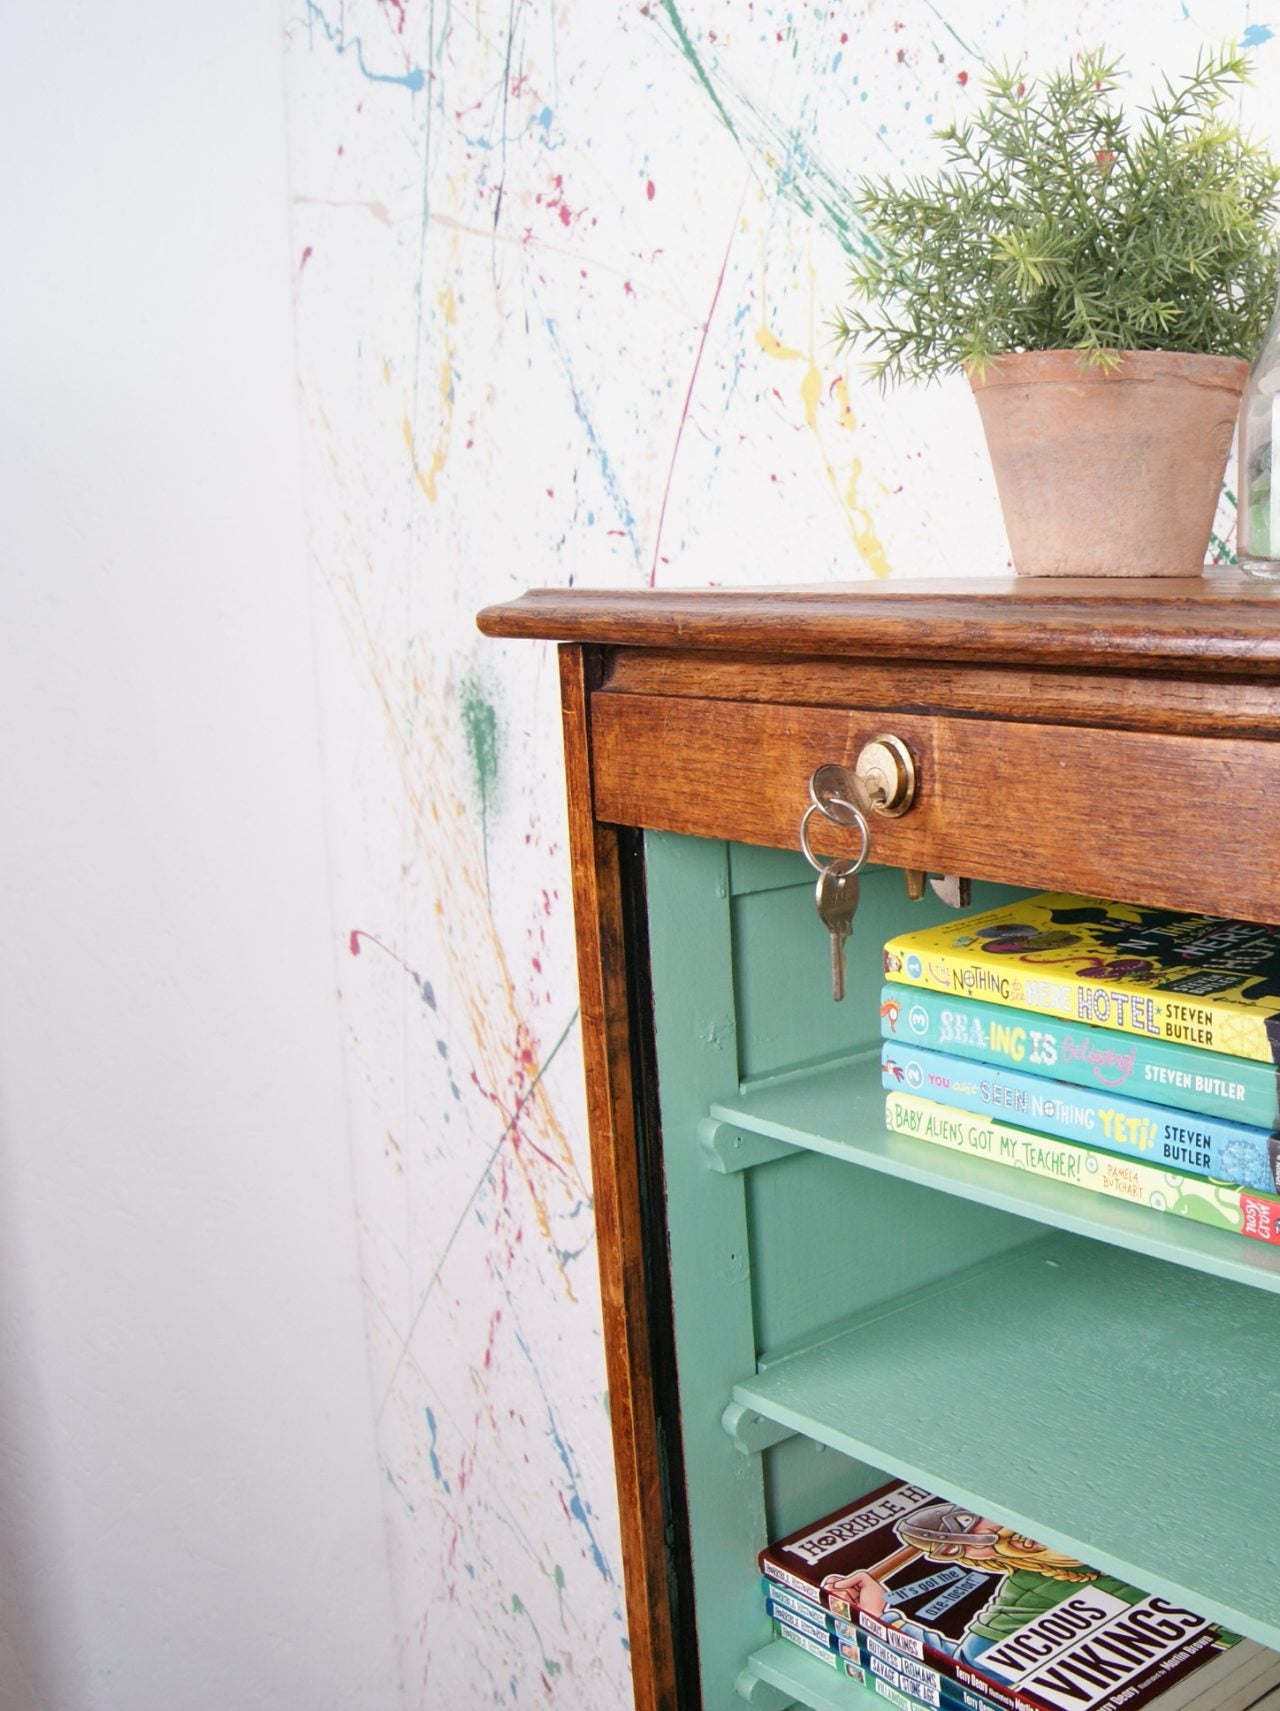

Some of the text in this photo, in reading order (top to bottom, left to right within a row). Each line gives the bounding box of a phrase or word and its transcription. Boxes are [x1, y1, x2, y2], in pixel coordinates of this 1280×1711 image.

[1173, 924, 1266, 956] HERE
[952, 965, 1010, 999] NOTHING
[1077, 986, 1160, 1035] HOTEL
[1166, 1004, 1213, 1027] STEVEN
[1030, 1030, 1058, 1065] IS
[1165, 1022, 1213, 1046] BUTLER
[1144, 1064, 1246, 1101] STEVEN BUTLER
[928, 1073, 950, 1089] YOU
[981, 1080, 1028, 1112] SEEN
[1032, 1095, 1095, 1130] NOTHING
[894, 1103, 923, 1131] BABY
[968, 1127, 995, 1152] GOT
[1000, 1135, 1018, 1159] MY
[1022, 1142, 1081, 1182] TEACHER!
[1164, 1124, 1212, 1149] STEVEN
[1163, 1146, 1211, 1169] BUTLER
[1103, 1176, 1144, 1199] BUTCHART
[1107, 1163, 1139, 1184] PAMELA
[798, 1500, 906, 1558] HORRIBLE
[937, 1569, 960, 1583] the
[889, 1629, 919, 1656] VIKINGS
[986, 1599, 1108, 1673] VICIOUS
[1032, 1597, 1206, 1704] VIKINGS
[872, 1659, 896, 1684] SAVAGE
[903, 1660, 937, 1689] ROMANS
